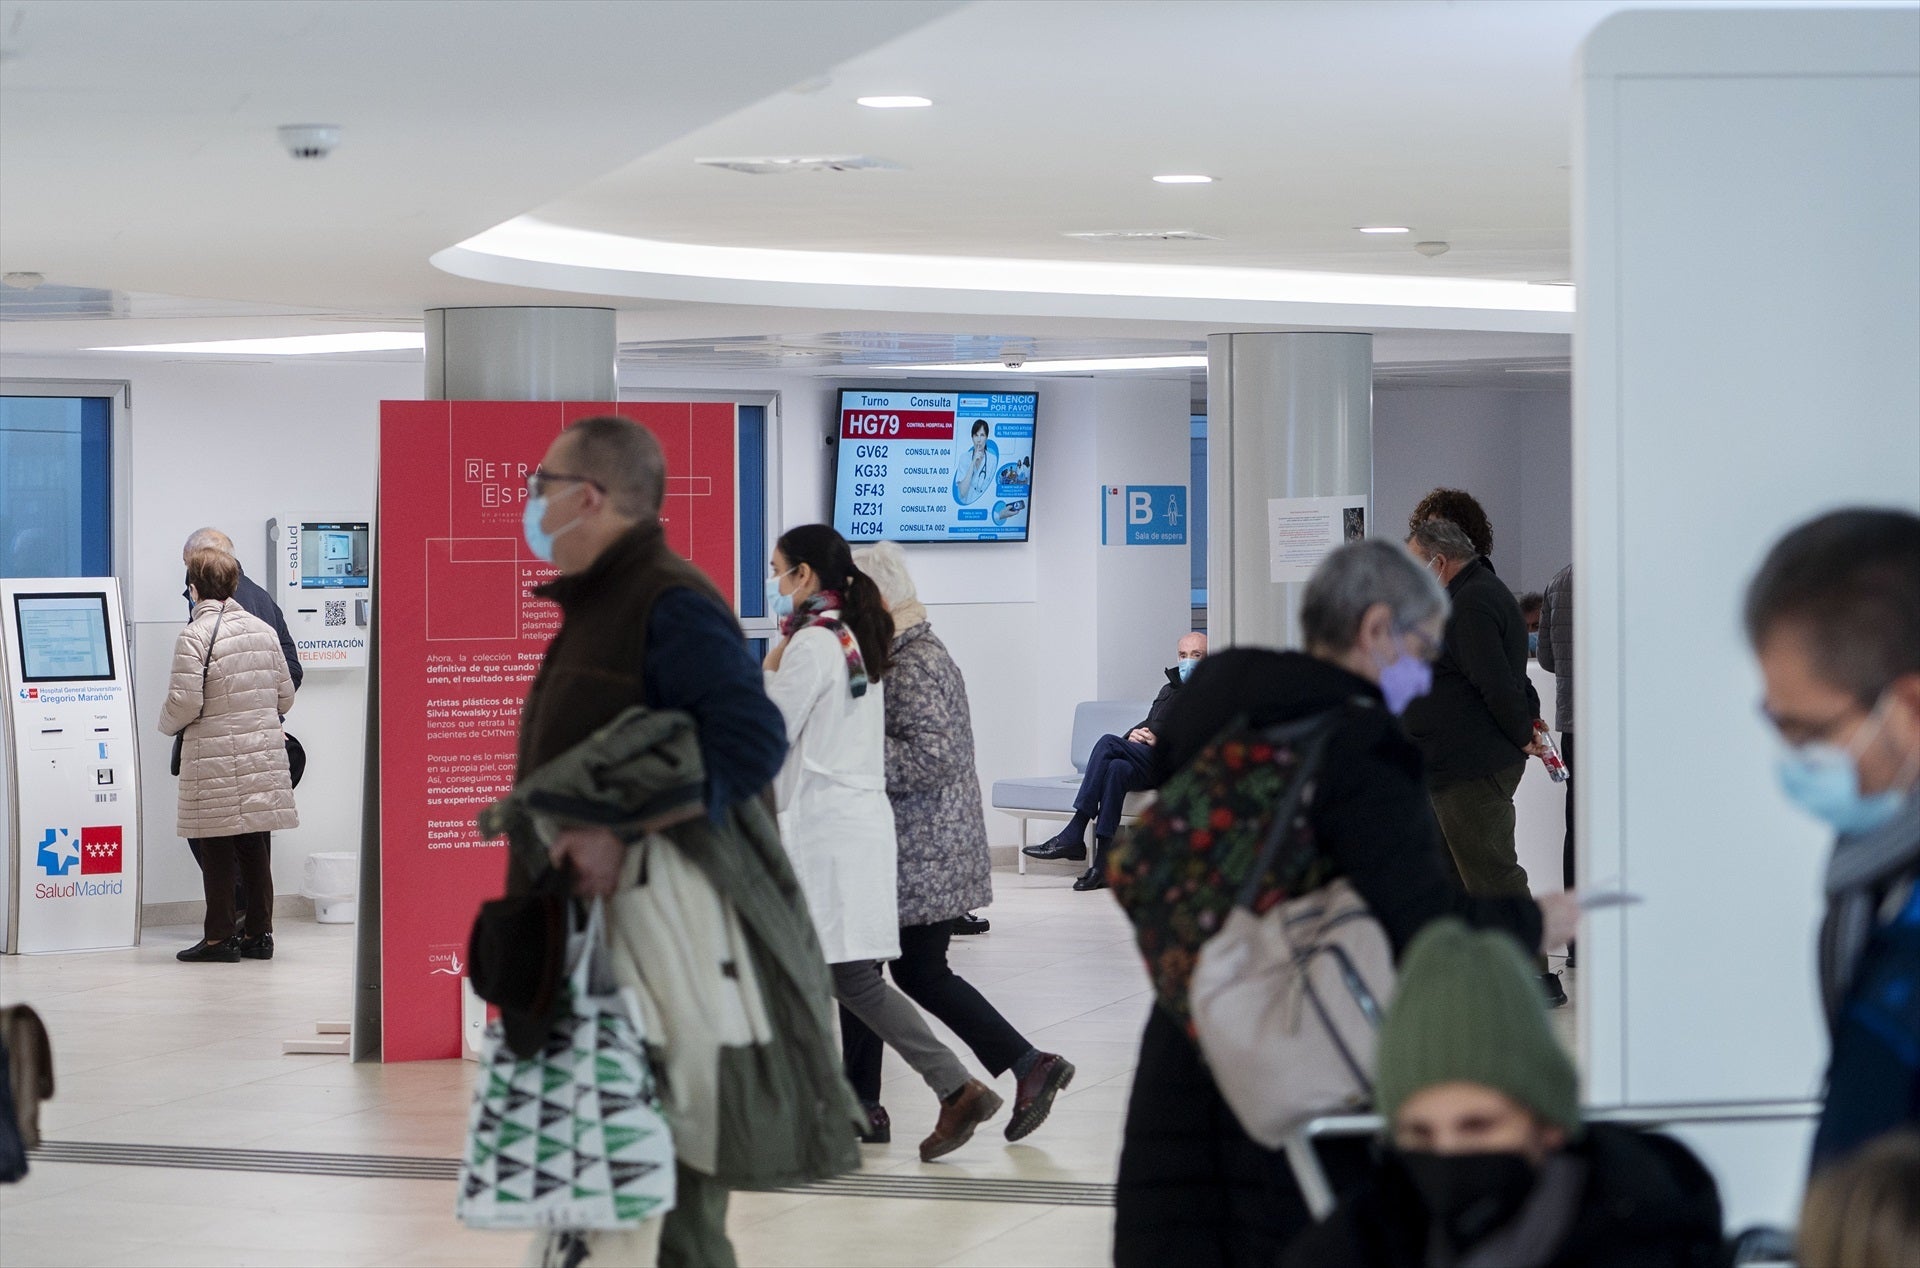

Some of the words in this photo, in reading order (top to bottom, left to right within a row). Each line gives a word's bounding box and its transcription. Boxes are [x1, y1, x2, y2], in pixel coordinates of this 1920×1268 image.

[861, 395, 890, 407] Turno
[910, 396, 951, 408] Consulta
[991, 394, 1035, 404] SILENCIO
[1008, 404, 1034, 412] FAVOR
[849, 414, 900, 435] HG79
[856, 445, 889, 459] GV62
[905, 448, 939, 456] CONSULTA
[854, 464, 888, 478] KG33
[903, 467, 938, 475] CONSULTA
[938, 467, 950, 475] 003
[485, 486, 529, 503] ESP
[854, 483, 885, 497] SF43
[902, 486, 936, 494] CONSULTA
[937, 486, 949, 494] 002
[853, 502, 884, 516] RZ31
[900, 505, 935, 513] CONSULTA
[935, 505, 947, 513] 003
[1129, 491, 1154, 525] B
[851, 521, 884, 535] HC94
[899, 524, 934, 532] CONSULTA
[934, 524, 946, 532] 002
[1135, 531, 1150, 540] Sala
[1150, 531, 1160, 540] de
[1161, 533, 1183, 542] espera
[522, 568, 532, 577] La
[521, 580, 539, 588] una
[522, 611, 559, 620] Negativo
[522, 621, 562, 630] plasmada
[297, 637, 364, 649] CONTRATACIÓN
[298, 650, 348, 661] TELEVISIÓN
[426, 654, 454, 663] Ahora,
[459, 654, 467, 662] la
[472, 652, 512, 662] colección
[426, 664, 467, 673] definitiva
[469, 663, 481, 672] de
[483, 664, 501, 675] que
[502, 662, 535, 672] cuando
[426, 675, 452, 684] unen,
[452, 674, 461, 683] el
[462, 673, 503, 683] resultado
[504, 674, 515, 682] es
[40, 687, 63, 695] Hospital
[40, 694, 76, 704] Gregorio
[78, 692, 114, 702] Marañón
[426, 698, 460, 707] Artistas
[462, 697, 500, 707] plásticos
[502, 696, 514, 705] de
[516, 696, 524, 705] la
[426, 708, 450, 718] Silvia
[451, 707, 491, 719] Kowalsky
[491, 708, 499, 718] y
[499, 707, 517, 716] Luis
[427, 719, 456, 729] lienzos
[458, 720, 475, 730] que
[477, 719, 505, 728] retrata
[507, 718, 515, 726] la
[427, 730, 468, 740] pacientes
[468, 729, 480, 738] de
[481, 728, 515, 738] CMTNm
[427, 753, 458, 764] Porque
[459, 752, 471, 761] no
[472, 752, 483, 761] es
[484, 751, 492, 761] lo
[494, 750, 520, 760] mism
[427, 765, 439, 774] en
[440, 764, 450, 773] su
[451, 762, 478, 774] propia
[480, 761, 497, 773] piel,
[427, 773, 442, 784] Así,
[446, 773, 502, 785] conseguimos
[427, 784, 475, 794] emociones
[475, 784, 493, 796] que
[427, 796, 442, 806] sus
[443, 792, 499, 807] experiencias.
[428, 818, 464, 829] Retratos
[428, 828, 459, 840] España
[461, 830, 467, 839] y
[468, 828, 482, 838] otr
[428, 840, 453, 850] como
[454, 838, 471, 849] una
[472, 836, 505, 848] manera
[35, 879, 123, 900] SaludMadrid
